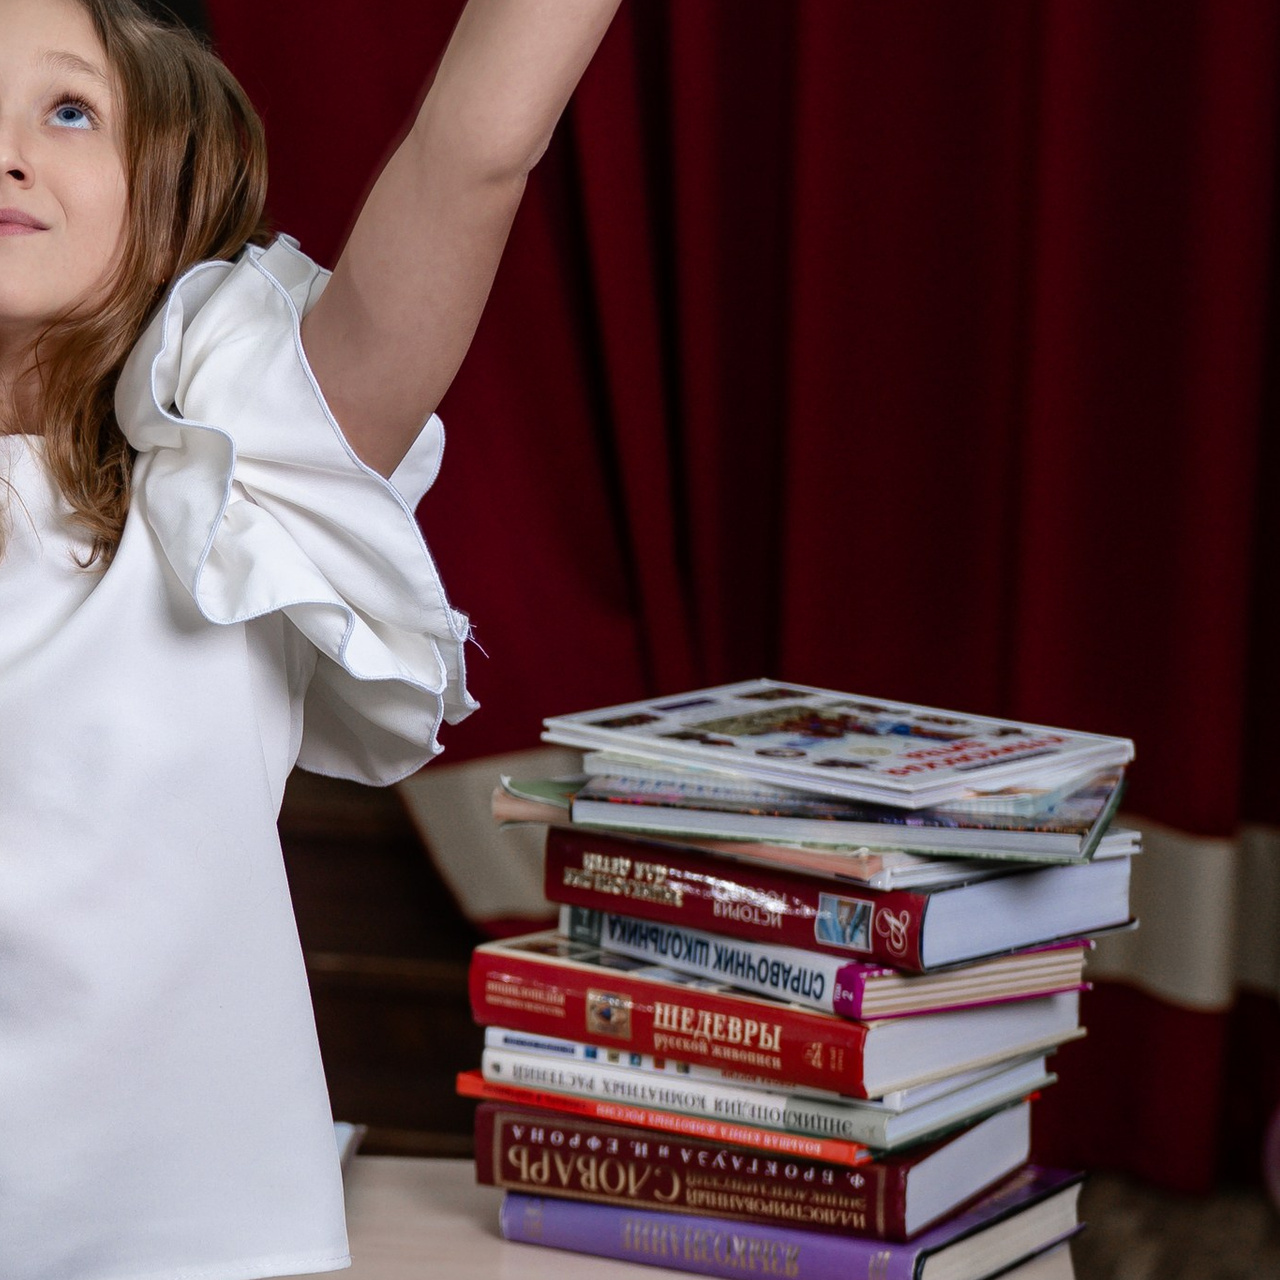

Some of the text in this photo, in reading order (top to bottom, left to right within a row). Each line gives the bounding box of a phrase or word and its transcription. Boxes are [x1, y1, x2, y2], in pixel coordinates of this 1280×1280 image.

[713, 899, 783, 929] ИСТОРИЯ
[608, 916, 826, 1001] СПРАВОЧНИК ШКОЛЬНИКА
[653, 1001, 782, 1053] ШЕДЕВРЫ
[653, 1032, 782, 1070] русской живописи
[512, 1064, 596, 1089] РАСТЕНИЙ
[601, 1079, 707, 1110] КОМНАТНЫХ
[713, 1098, 853, 1136] ЭНЦИКЛОПЕДИЯ
[512, 1124, 619, 1154] ЕФРОНА
[507, 1144, 681, 1202] СЛОВАРЬ
[681, 1148, 834, 1185] БРОКГАУЗА
[685, 1187, 867, 1230] ИЛЛЮСТРИРОВАННЫЙ
[623, 1218, 802, 1278] ЯЗЫКОЗНАНИЕ
